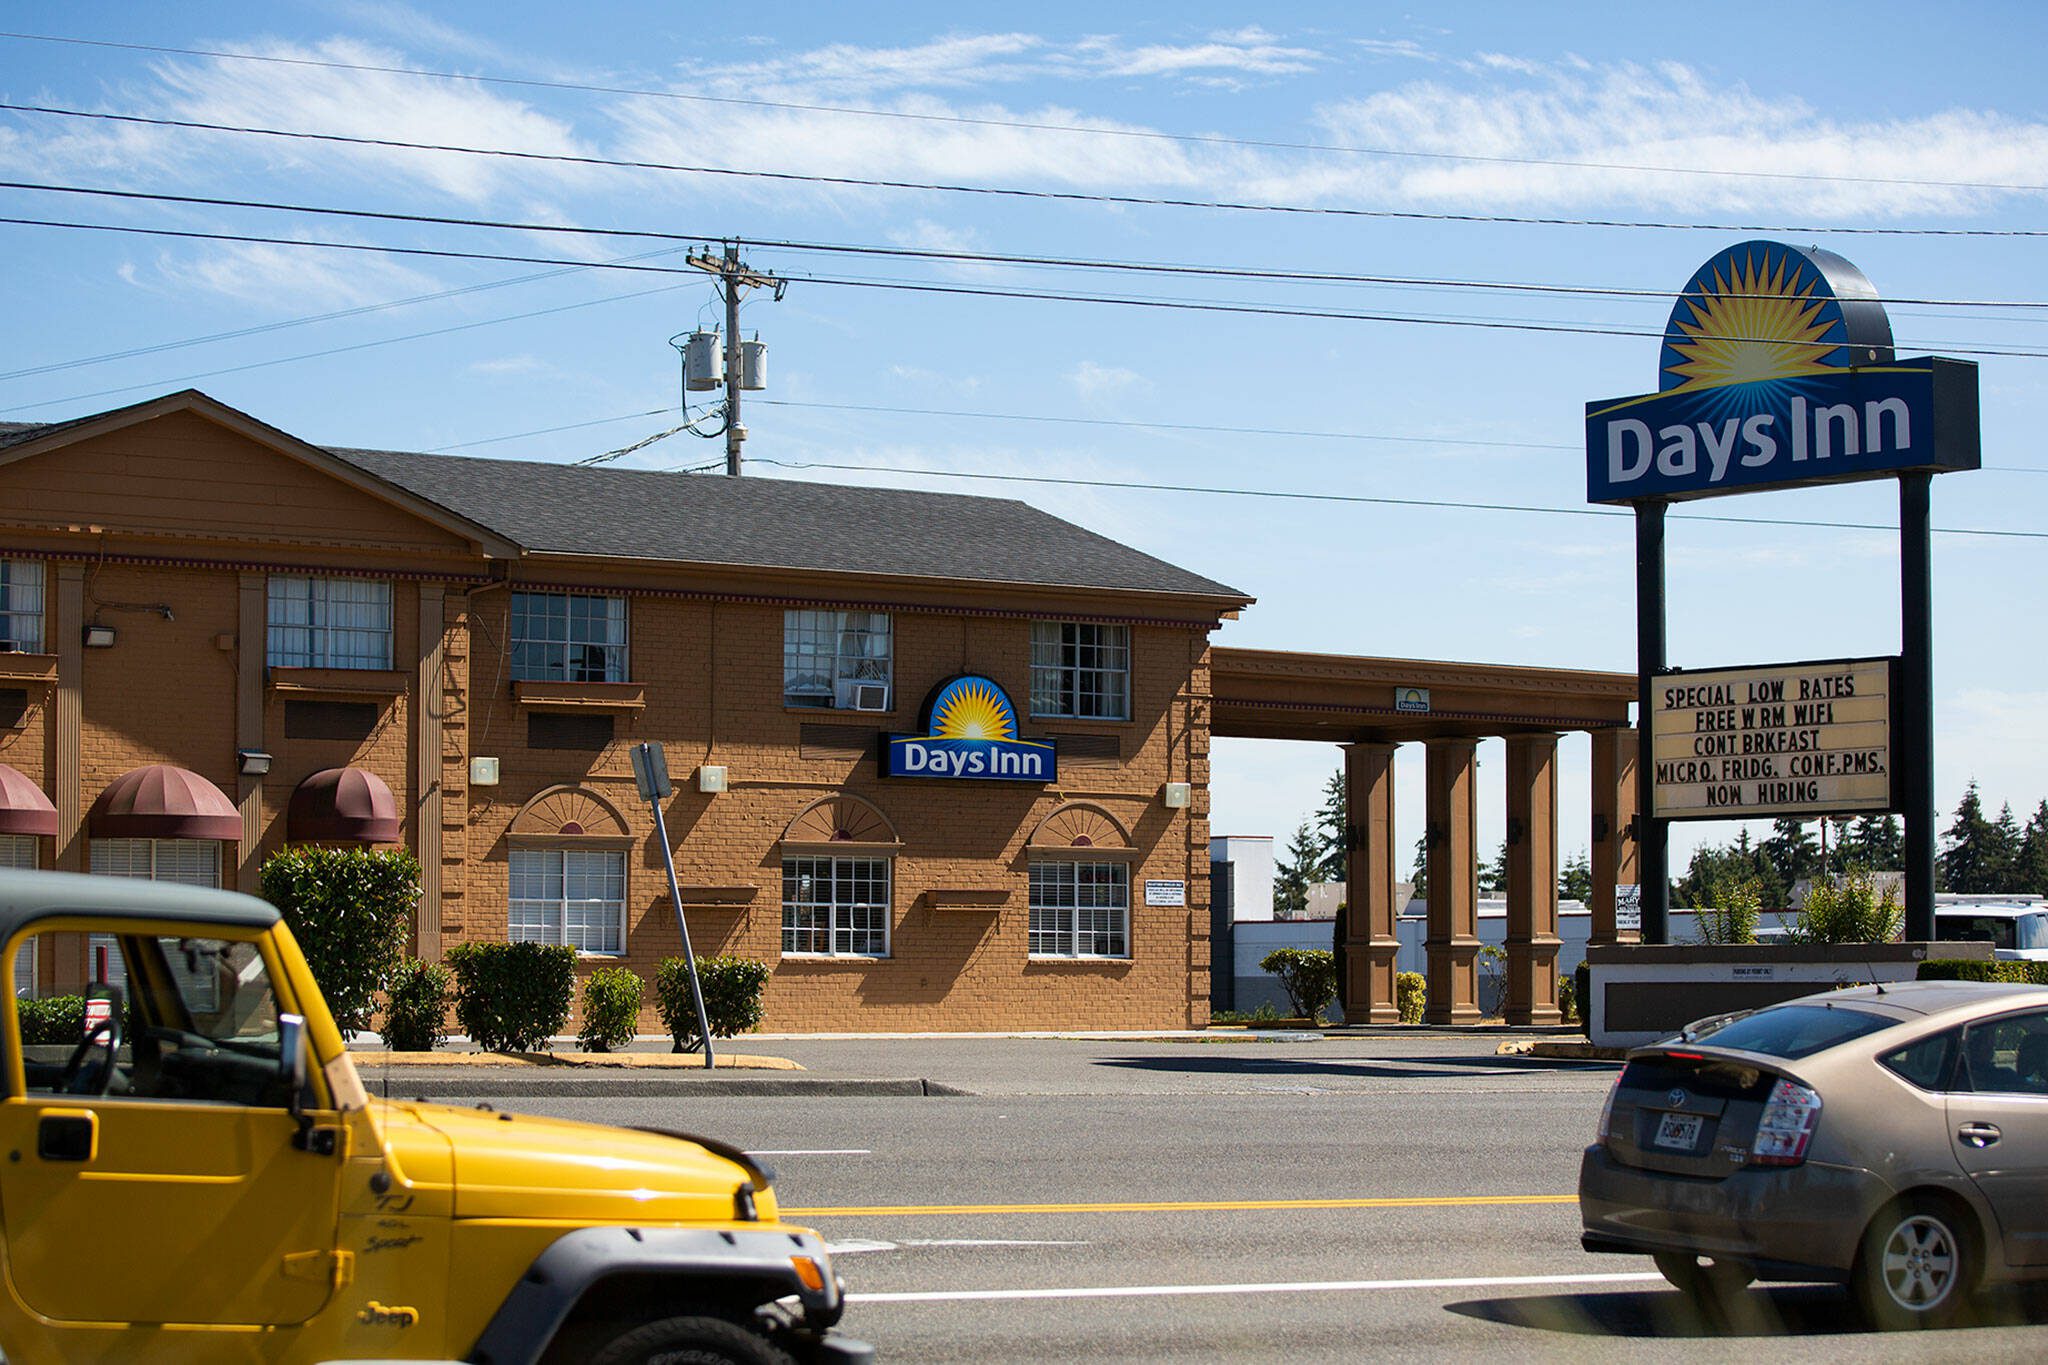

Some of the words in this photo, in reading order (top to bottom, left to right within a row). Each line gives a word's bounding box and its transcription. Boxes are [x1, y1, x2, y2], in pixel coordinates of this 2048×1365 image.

[1607, 413, 1777, 483] Days
[1790, 396, 1911, 463] Inn
[1664, 684, 1736, 710] SPECIAL
[1748, 680, 1785, 705] LOW
[1799, 675, 1855, 700] RATES
[1695, 709, 1736, 732] FREE
[1742, 708, 1755, 729] W
[1761, 705, 1786, 728] RM
[1793, 702, 1834, 726] WIFI
[1694, 734, 1737, 757] CONT
[1743, 730, 1820, 754] BRKFAST
[905, 743, 985, 776] Days
[990, 746, 1042, 775] Inn
[1722, 757, 1779, 780] FRIDG.
[1706, 785, 1743, 807] NOW
[1758, 780, 1819, 805] HIRING
[357, 1301, 419, 1328] Jeep
